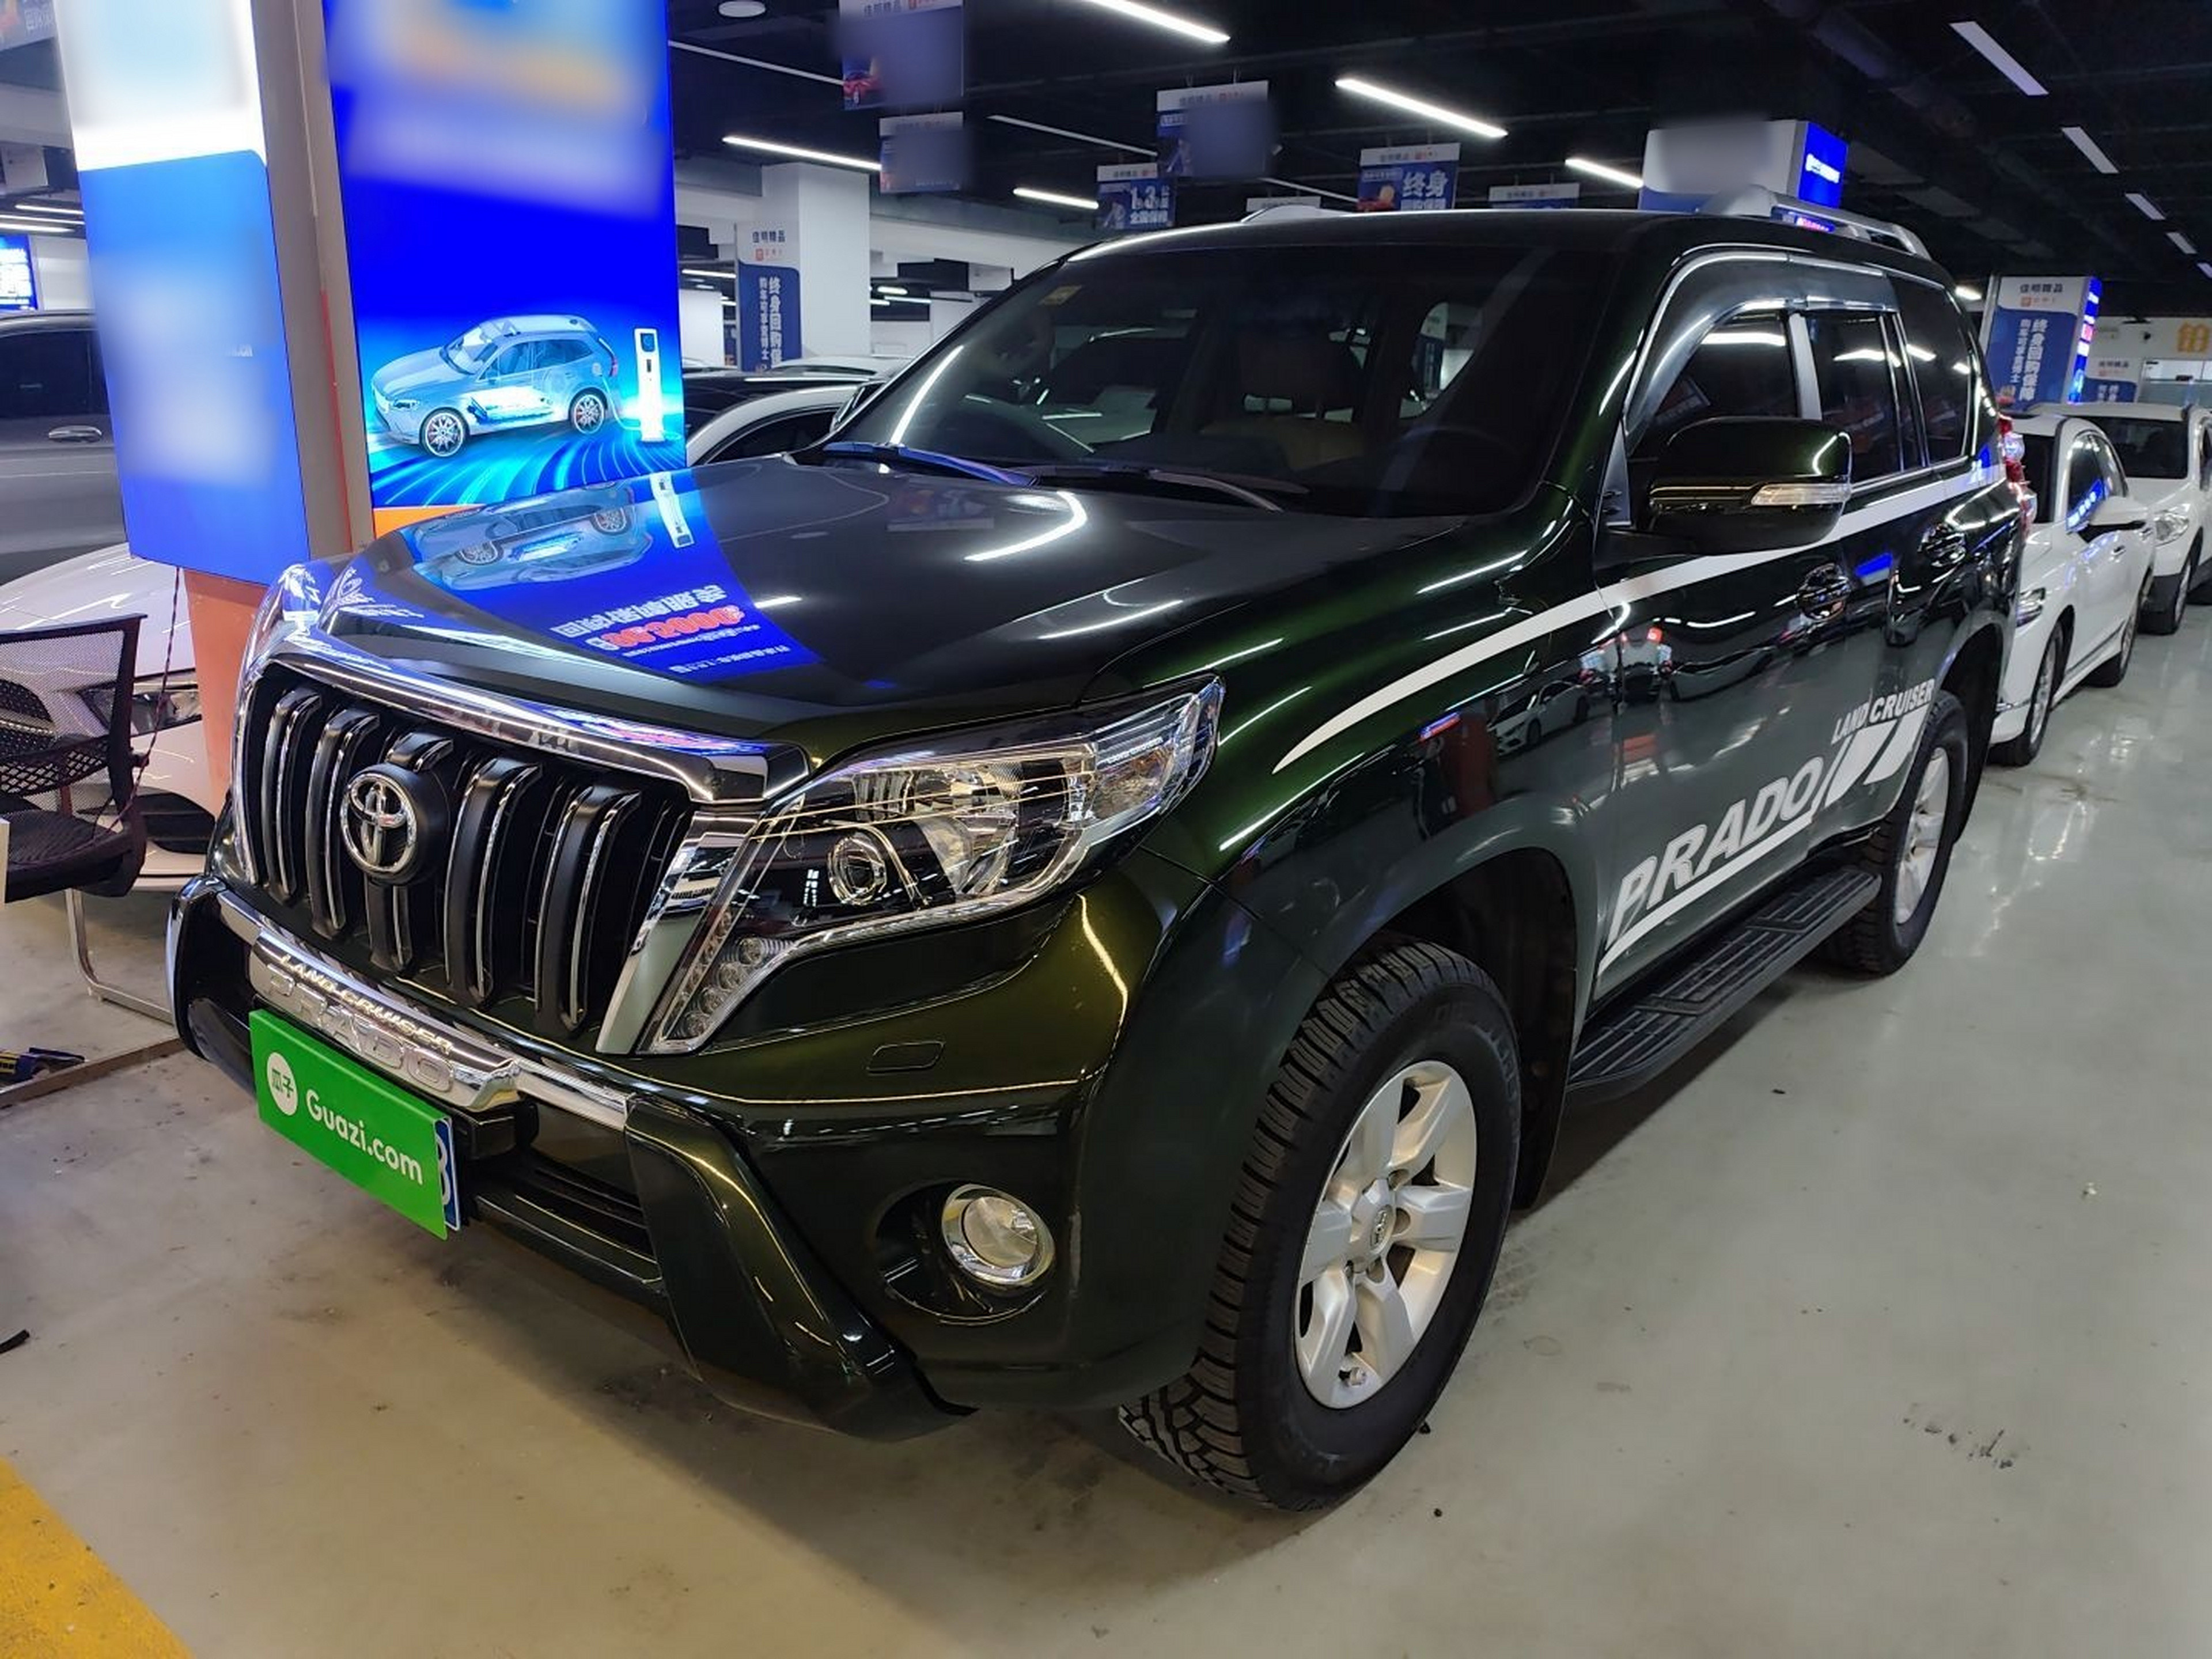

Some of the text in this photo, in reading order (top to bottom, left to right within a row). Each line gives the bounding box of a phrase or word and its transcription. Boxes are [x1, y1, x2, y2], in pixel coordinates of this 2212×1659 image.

[1831, 678, 1935, 745] LAND CRUISER
[1605, 756, 1825, 951] PRADO
[266, 963, 454, 1093] PRADO
[281, 954, 453, 1055] LAND CRUISER
[271, 1068, 295, 1099] 瓜子
[306, 1089, 423, 1185] Guazi.com
